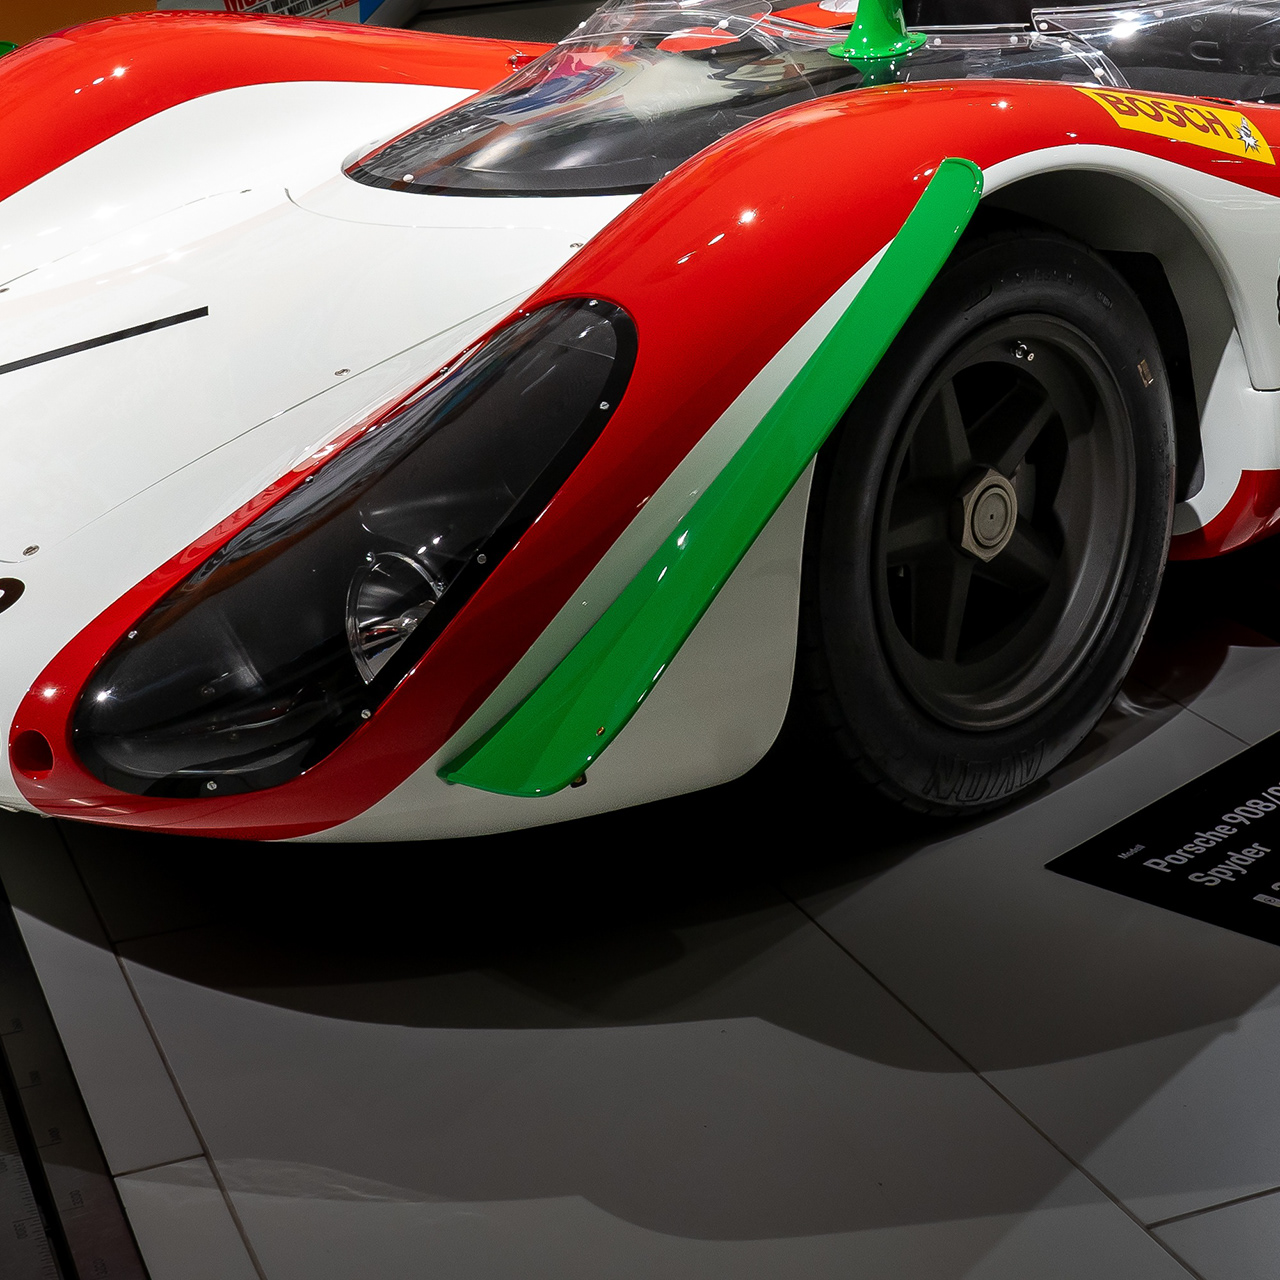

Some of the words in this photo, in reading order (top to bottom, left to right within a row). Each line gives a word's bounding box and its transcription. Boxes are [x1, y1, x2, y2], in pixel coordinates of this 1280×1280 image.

[1110, 90, 1237, 142] BOSCH
[1143, 822, 1238, 873] Porsche
[1188, 840, 1271, 887] Spyder
